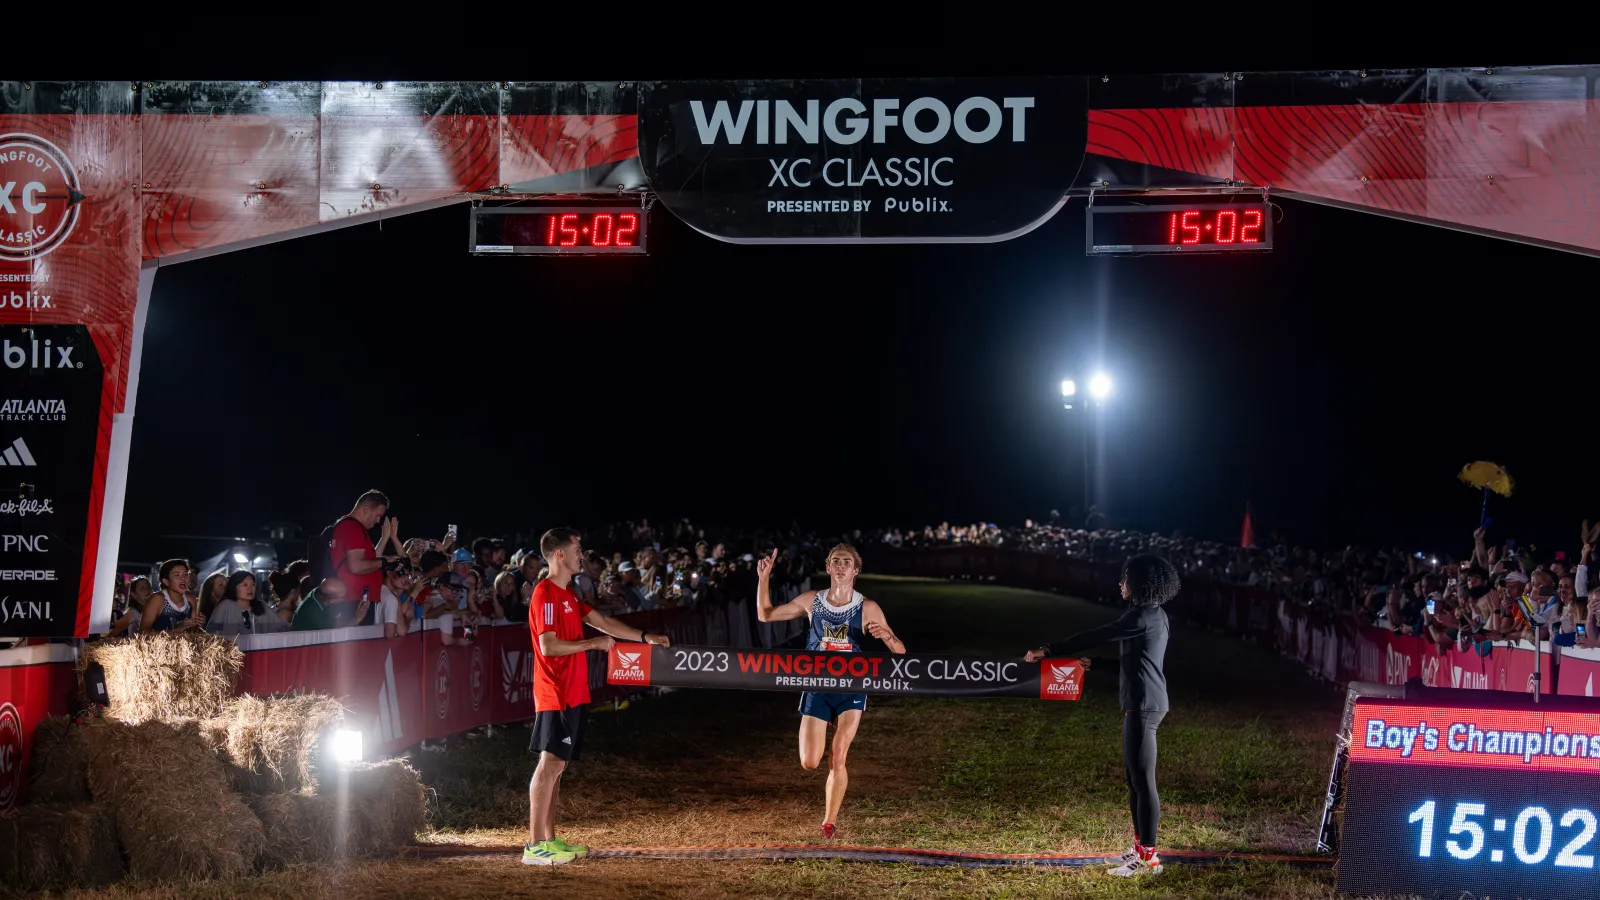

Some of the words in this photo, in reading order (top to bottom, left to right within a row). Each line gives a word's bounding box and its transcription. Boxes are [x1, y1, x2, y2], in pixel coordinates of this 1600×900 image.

[690, 97, 1035, 145] WINGFOOT
[768, 159, 810, 187] XC
[823, 158, 953, 187] CLASSIC
[0, 181, 47, 214] XC
[768, 200, 839, 212] PRESENTED
[853, 200, 872, 212] BY
[39, 274, 50, 282] BY
[0, 399, 67, 414] ATLANTA
[2, 534, 49, 552] PNC
[612, 669, 645, 677] ATLANTA
[674, 651, 730, 673] 2023
[737, 652, 883, 678] WINGFOOT
[889, 658, 920, 679] XC
[927, 659, 1018, 683] CLASSIC
[775, 676, 837, 687] PRESENTED
[839, 678, 854, 688] BY
[1047, 683, 1079, 691] ATLANTA
[1365, 719, 1439, 757] Boy's
[1447, 723, 1600, 763] Champions
[1408, 801, 1598, 869] 15:02
